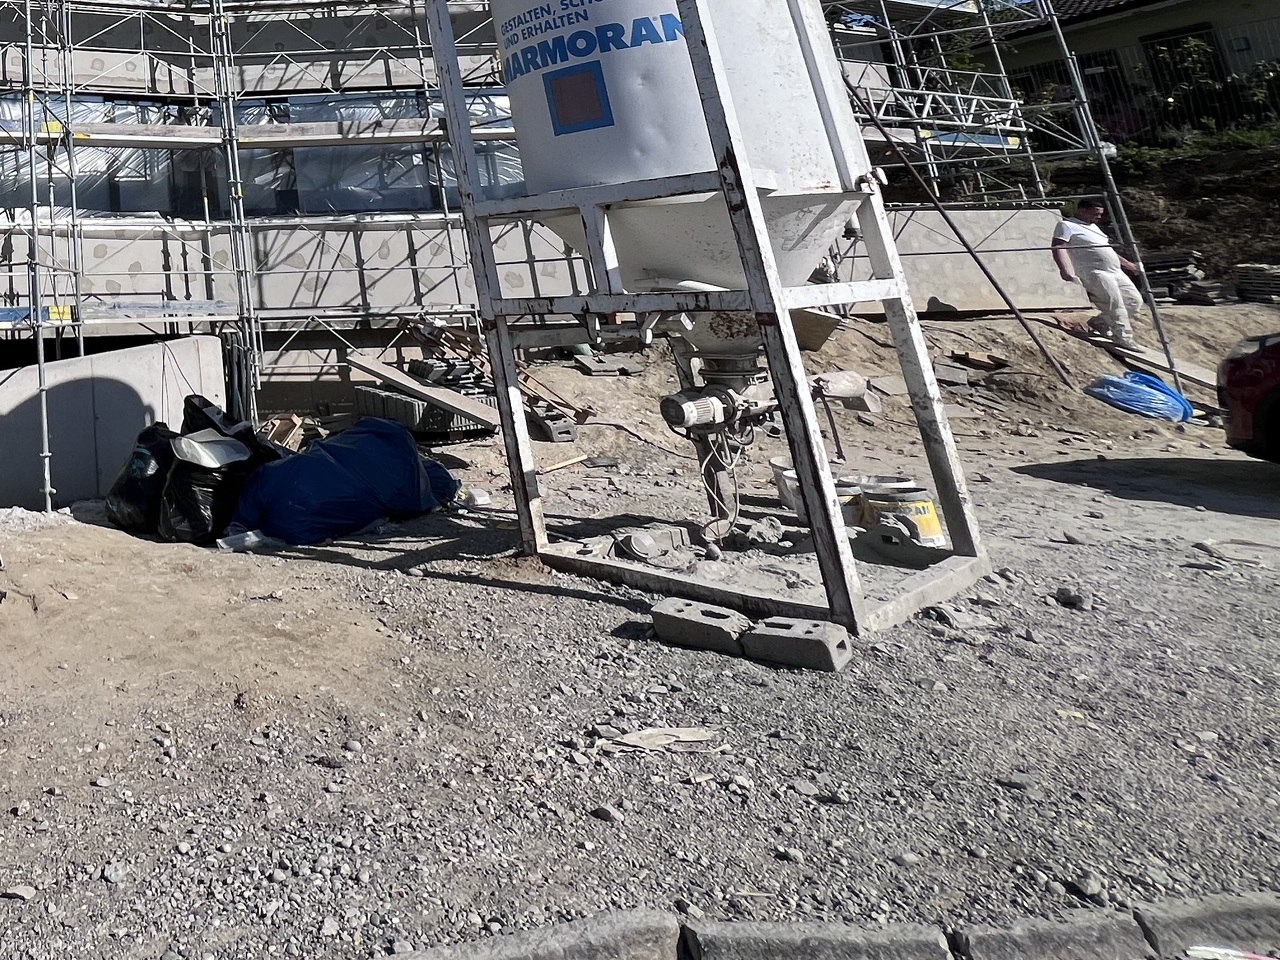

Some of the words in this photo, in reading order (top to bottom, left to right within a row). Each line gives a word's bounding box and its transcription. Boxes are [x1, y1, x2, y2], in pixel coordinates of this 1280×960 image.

[500, 3, 556, 37] GESTALTEN,
[504, 33, 519, 49] UND
[521, 9, 589, 41] ERHALTEN
